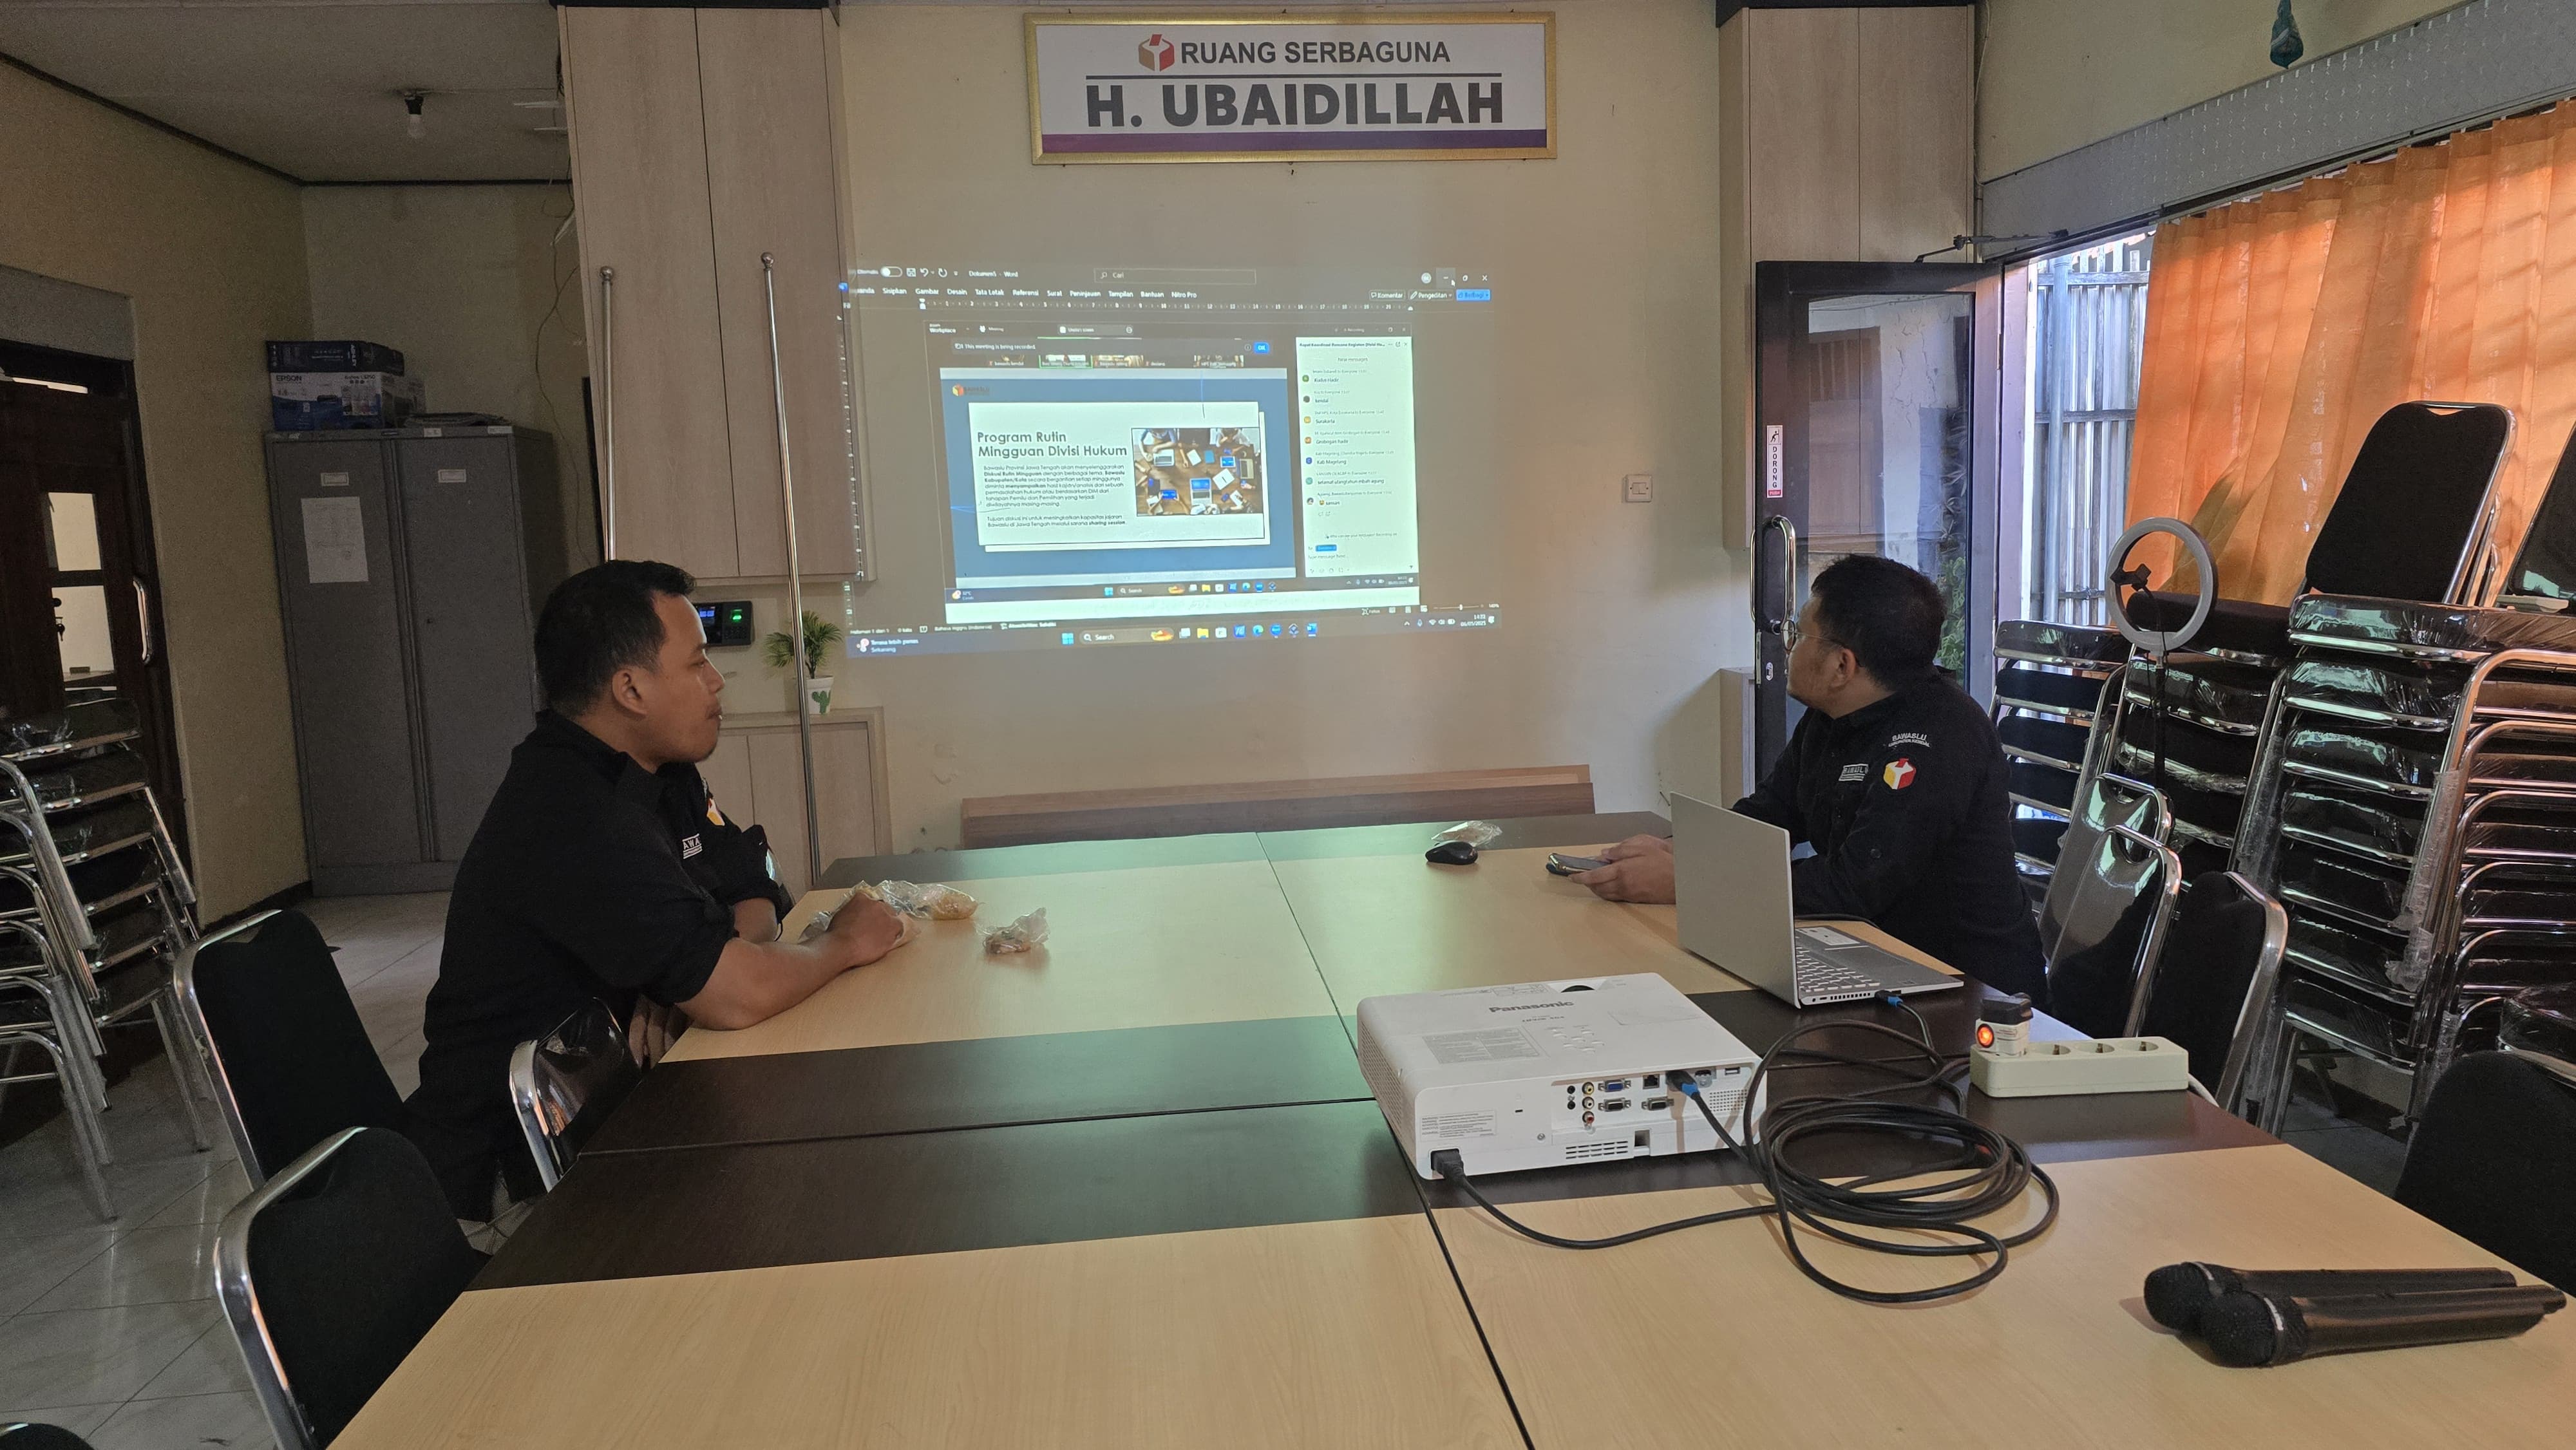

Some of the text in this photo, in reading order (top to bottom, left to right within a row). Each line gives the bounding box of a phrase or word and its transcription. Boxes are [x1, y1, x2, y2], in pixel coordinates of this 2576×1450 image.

[1181, 41, 1450, 63] RUANG SERBAGUNA
[1086, 82, 1503, 127] H. UBAIDILLAH
[978, 431, 1066, 444] Program Rutin
[978, 446, 1127, 458] Mingguan Divisi Hukum
[1892, 733, 1927, 741] BAWASLU
[1489, 1001, 1574, 1012] Panasonic
